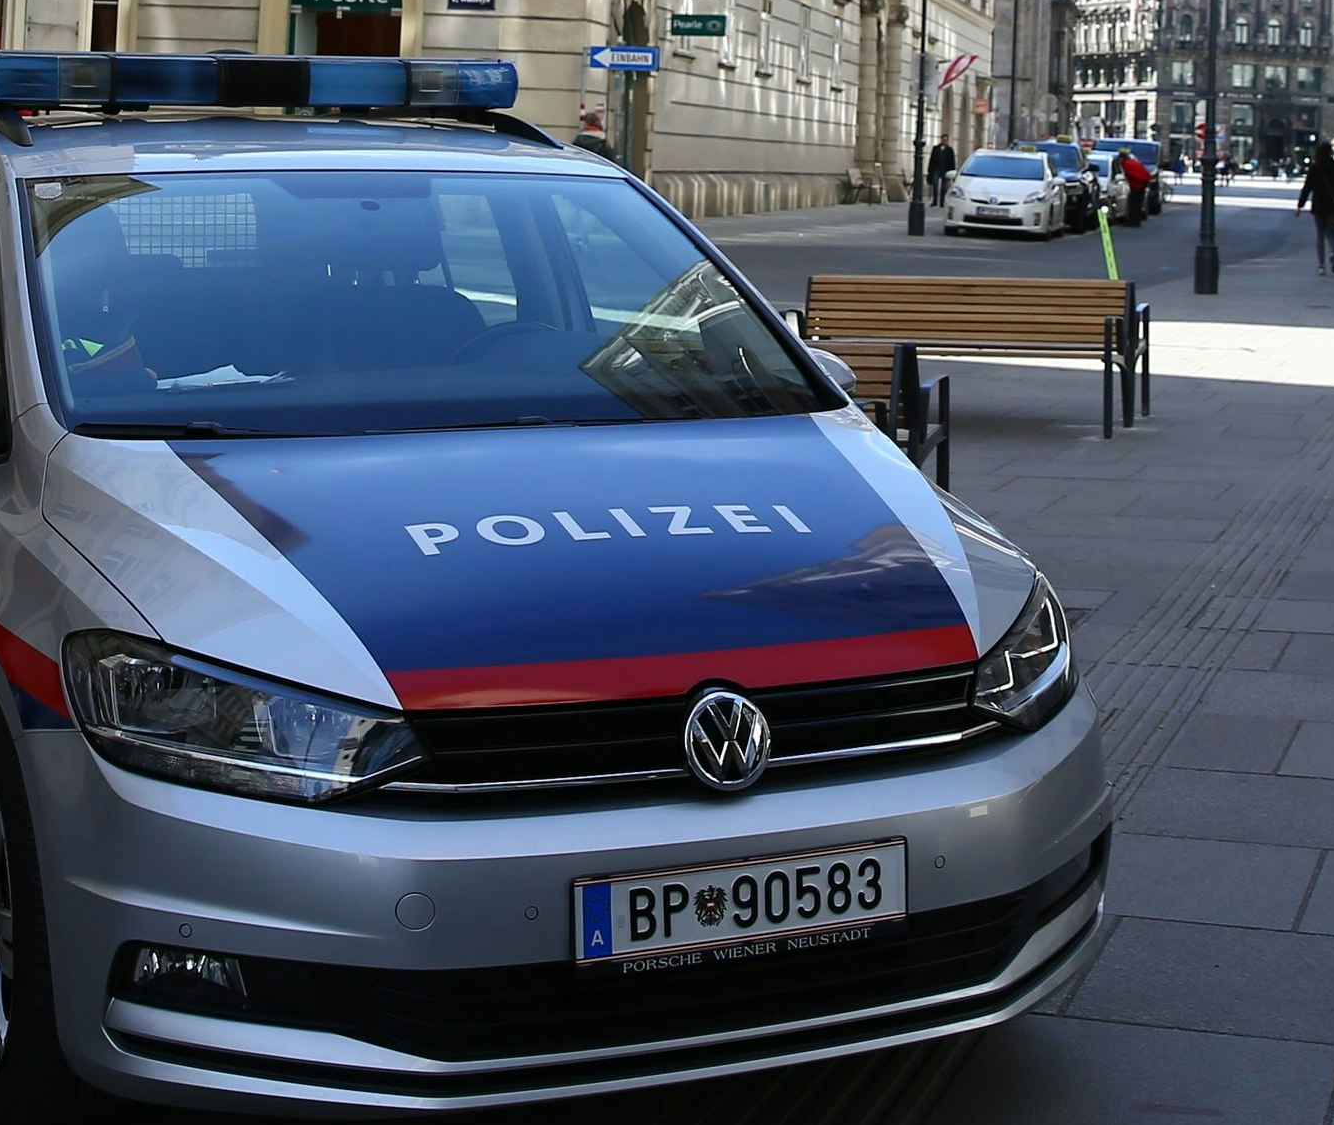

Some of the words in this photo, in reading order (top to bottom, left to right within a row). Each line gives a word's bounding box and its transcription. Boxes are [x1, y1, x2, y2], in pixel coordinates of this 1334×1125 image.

[673, 19, 703, 30] Pearle
[611, 52, 650, 64] EINBAHN
[405, 502, 814, 557] POLIZEI
[628, 882, 690, 942] BP
[730, 857, 883, 928] 90583
[590, 930, 604, 947] A
[622, 952, 703, 974] PORSCHE
[713, 941, 777, 962] WIENER
[786, 926, 872, 951] NEUSTADT
